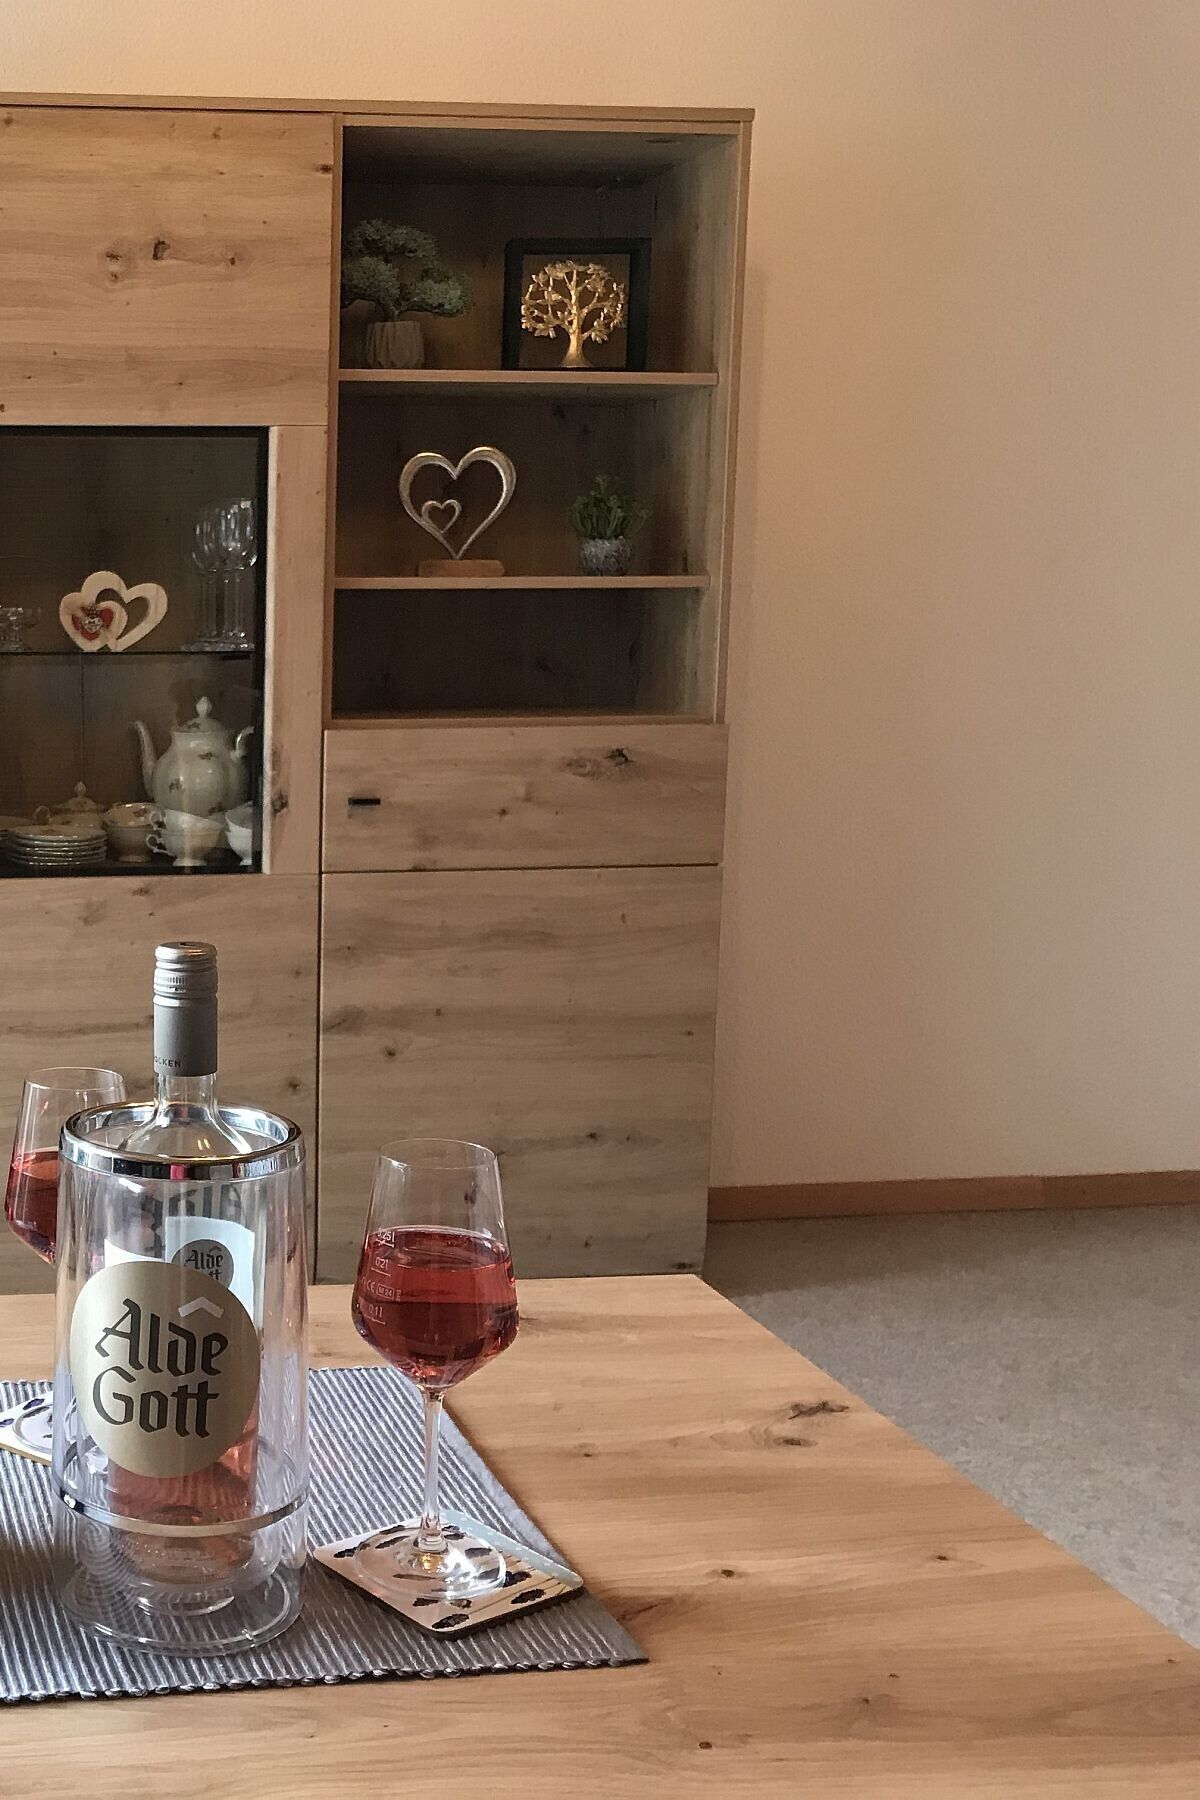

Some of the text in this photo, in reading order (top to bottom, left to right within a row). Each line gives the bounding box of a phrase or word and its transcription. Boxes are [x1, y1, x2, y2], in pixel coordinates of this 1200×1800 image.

[183, 1249, 224, 1270] Alde
[94, 1298, 229, 1377] Alde
[92, 1365, 220, 1439] Gott
